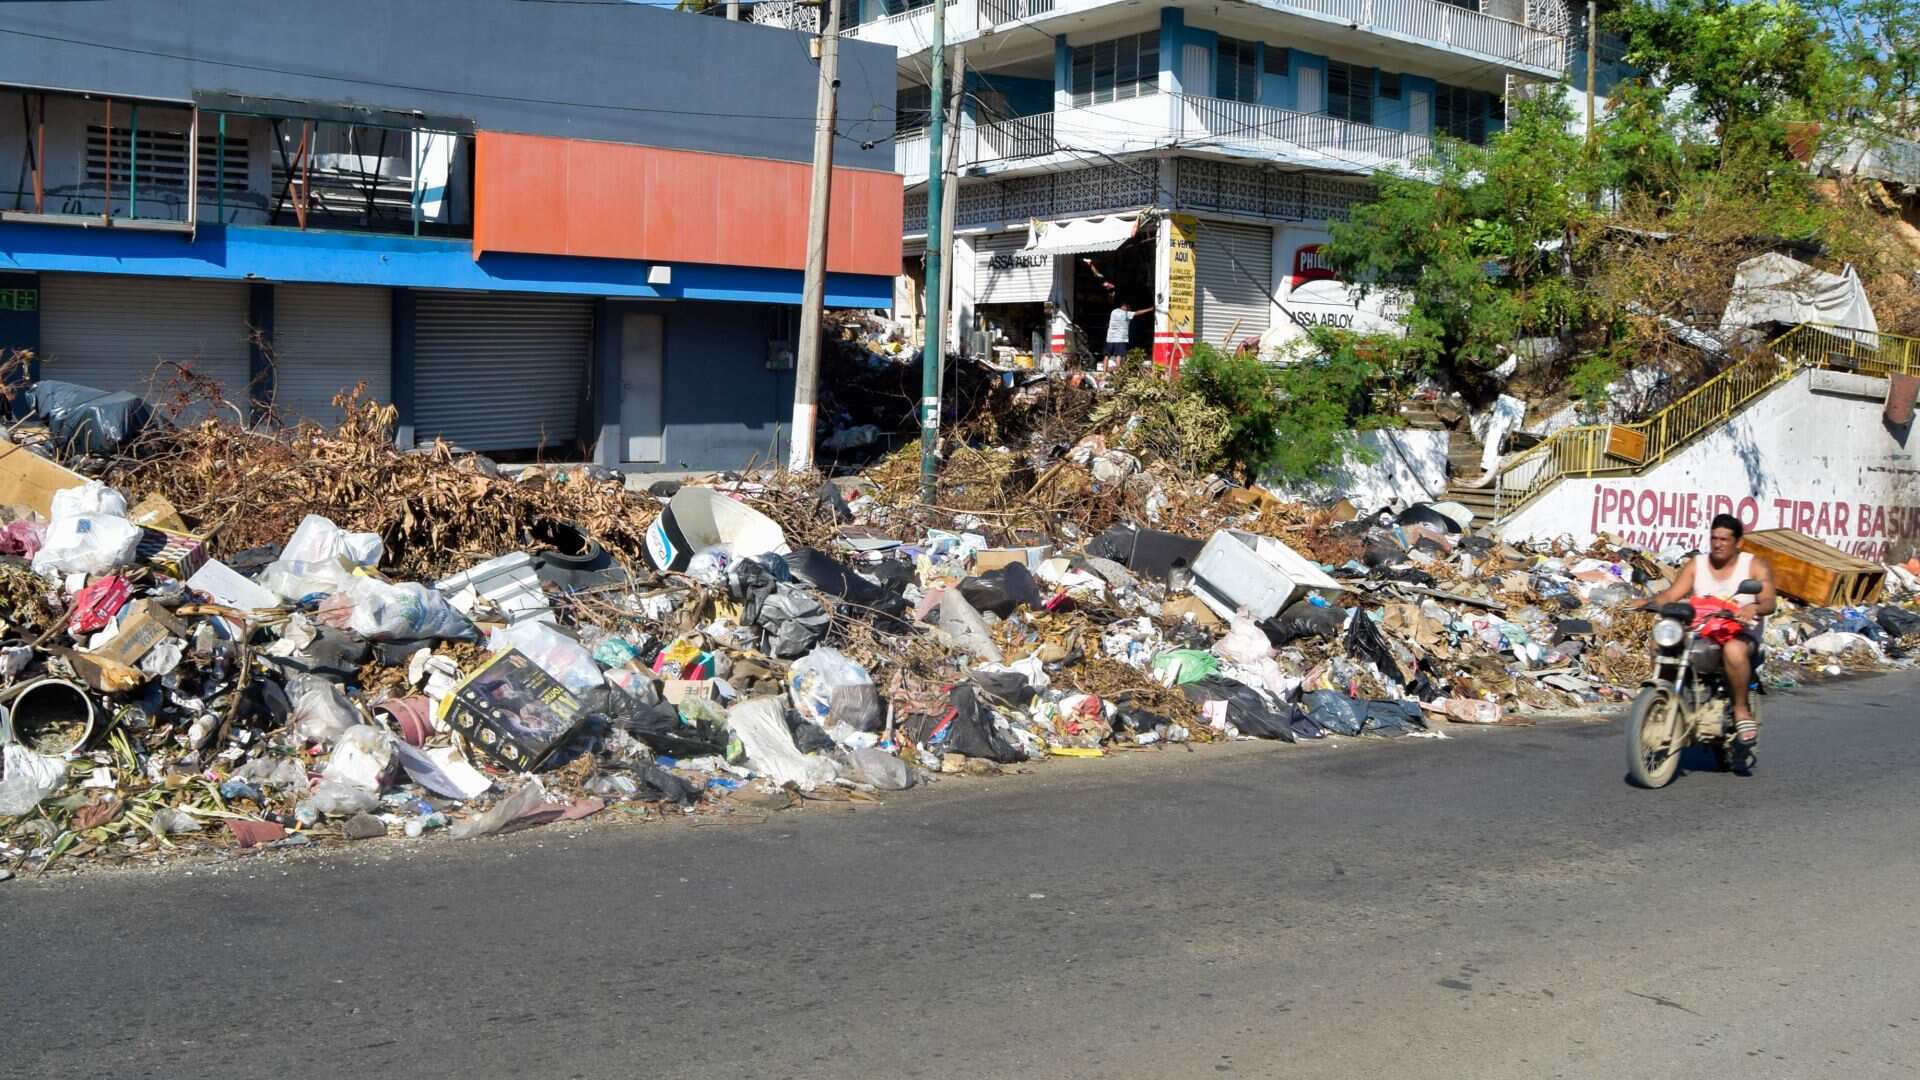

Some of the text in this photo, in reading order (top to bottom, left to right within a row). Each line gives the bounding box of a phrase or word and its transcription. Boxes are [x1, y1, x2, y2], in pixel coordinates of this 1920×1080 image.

[988, 254, 1048, 270] ASSA ABLOY
[1290, 311, 1354, 329] ASSA ABLOY
[1773, 498, 1850, 537] TIRAR
